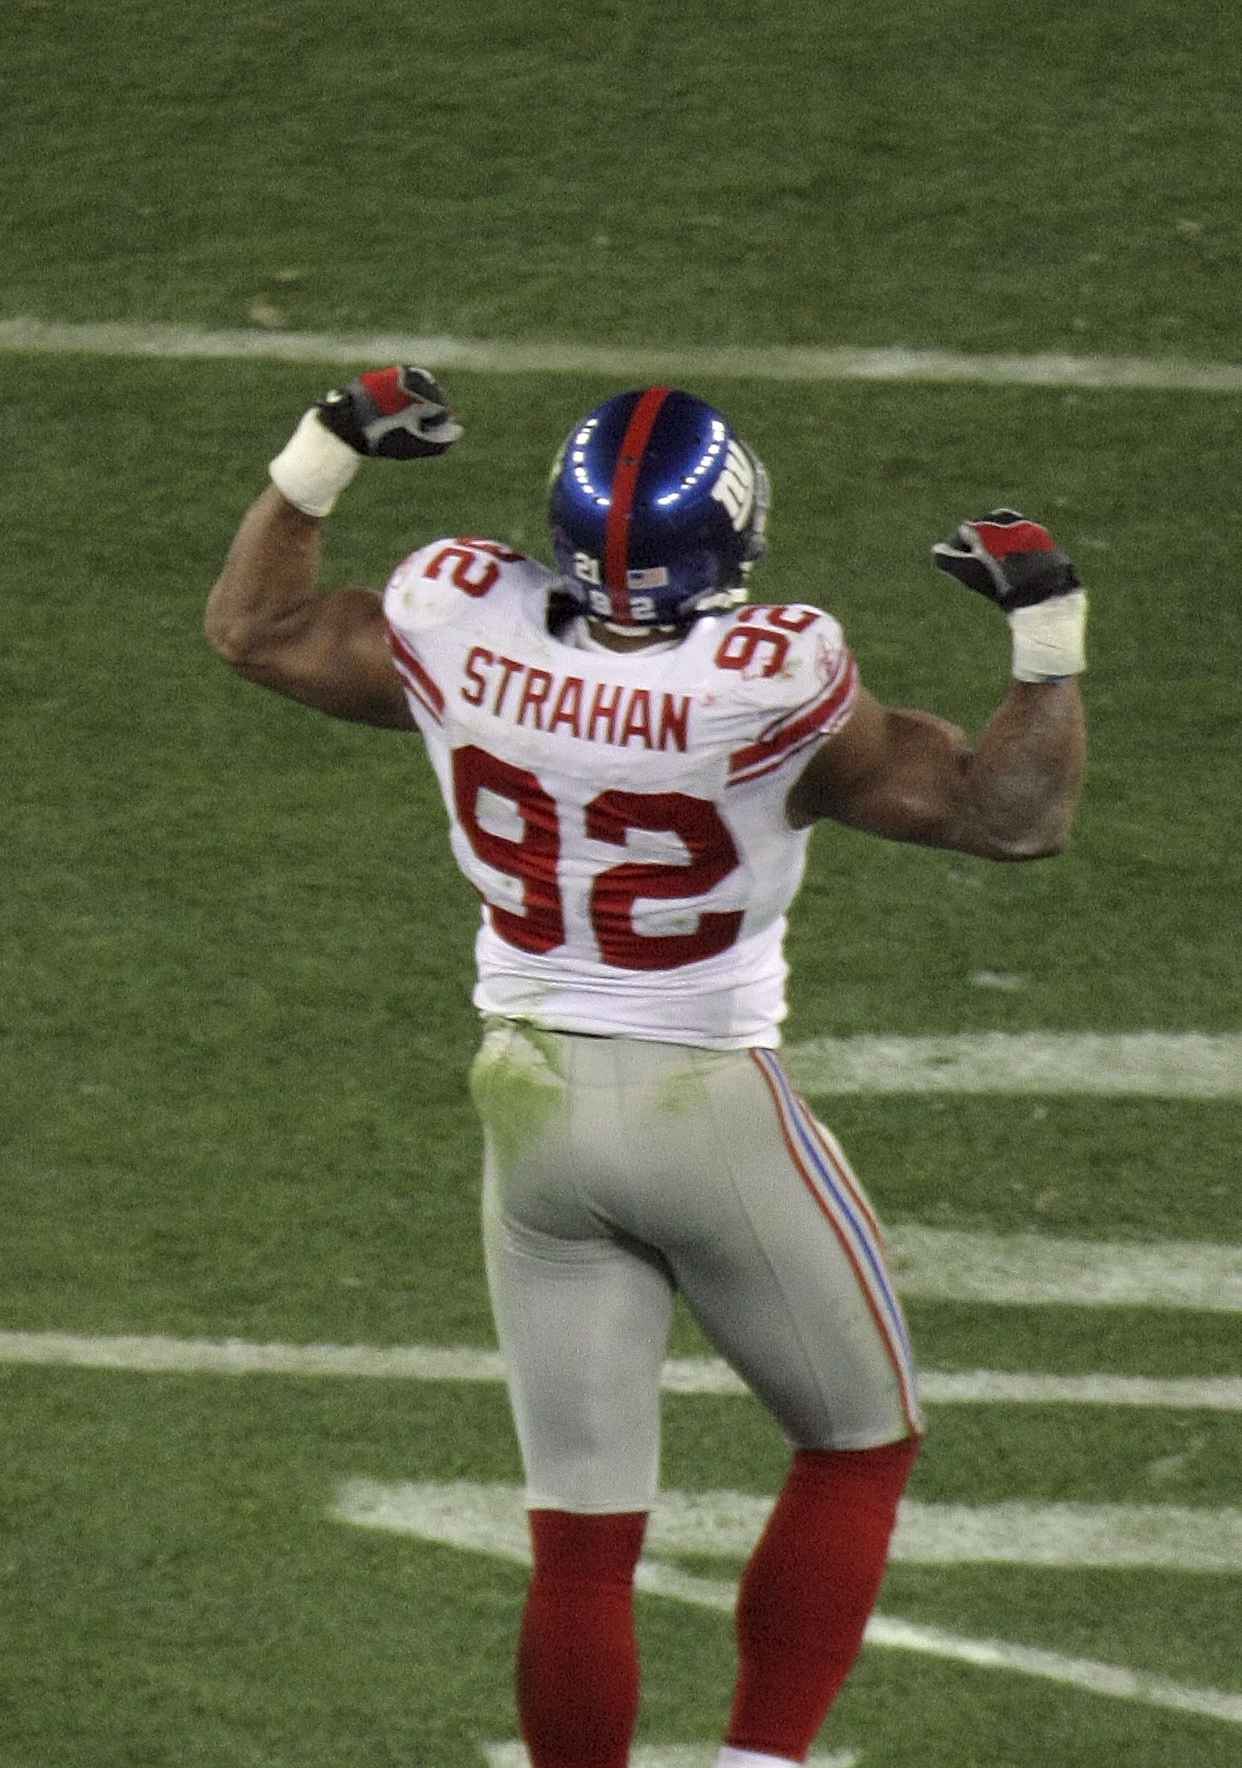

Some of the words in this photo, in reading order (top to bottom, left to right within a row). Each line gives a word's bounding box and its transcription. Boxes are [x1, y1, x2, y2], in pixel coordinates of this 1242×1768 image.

[573, 552, 602, 586] 21
[461, 646, 692, 752] STRAHAN
[452, 744, 746, 972] 92
